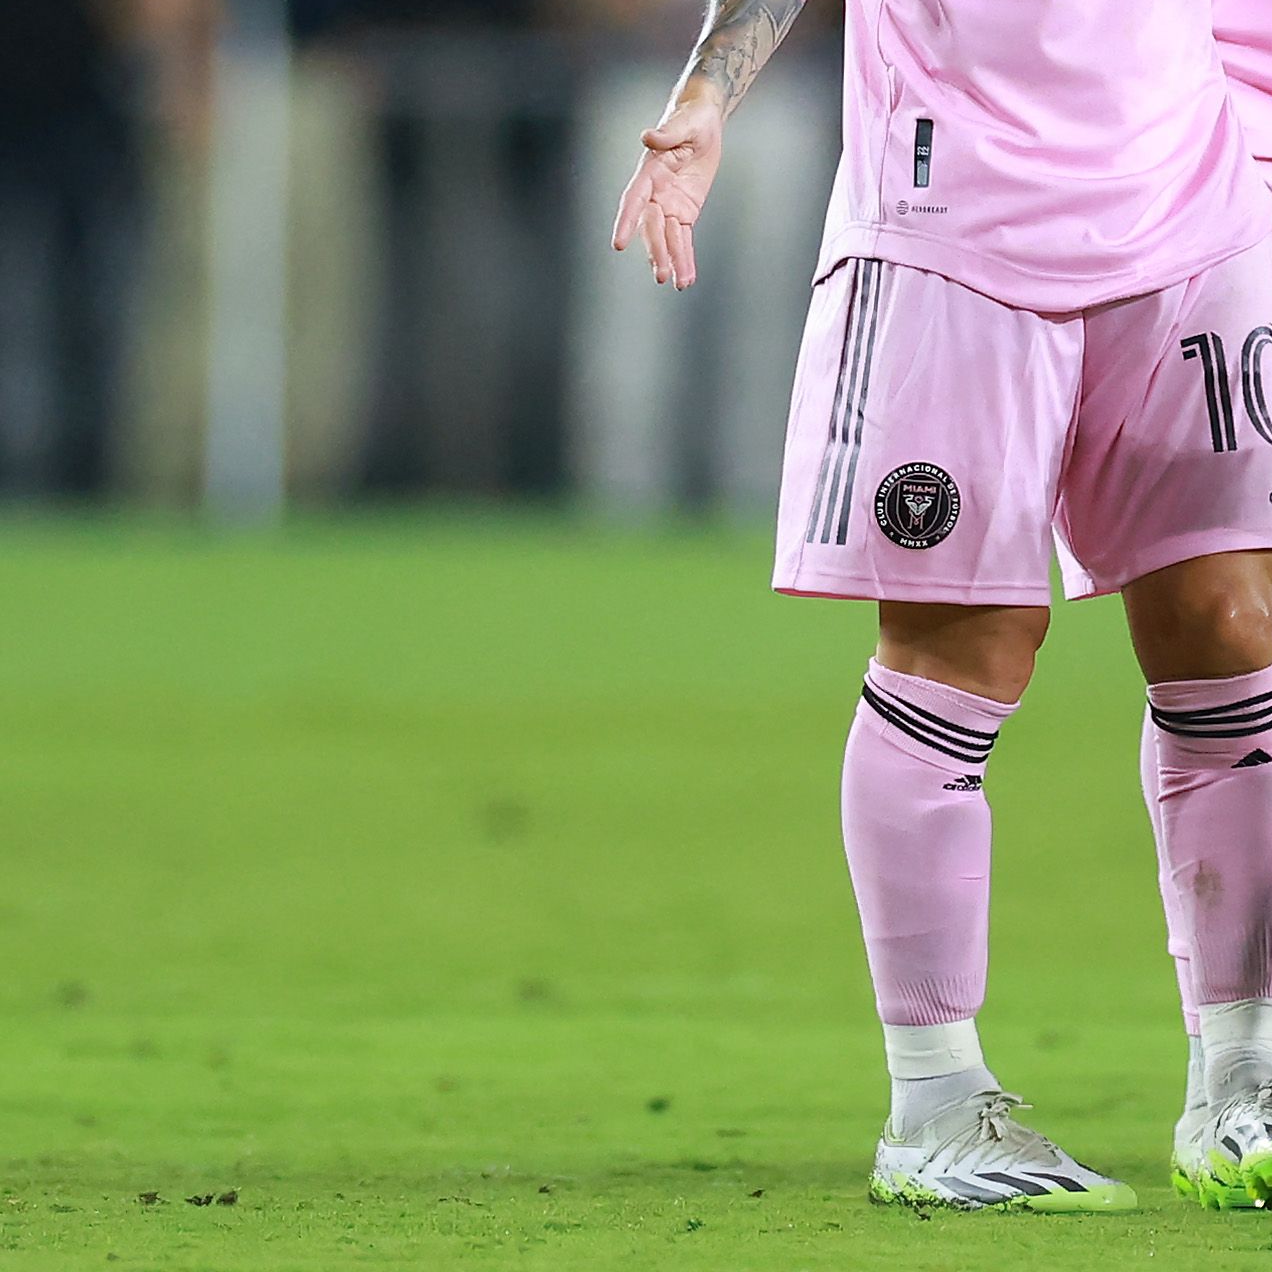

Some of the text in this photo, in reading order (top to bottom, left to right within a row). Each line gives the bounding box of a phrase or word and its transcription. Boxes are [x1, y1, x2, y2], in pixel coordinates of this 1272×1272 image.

[878, 465, 948, 497] INTERNACIONAL
[903, 485, 937, 494] MIAMI
[947, 483, 957, 494] DE
[877, 502, 888, 526] CLUB
[900, 538, 928, 547] MMXX
